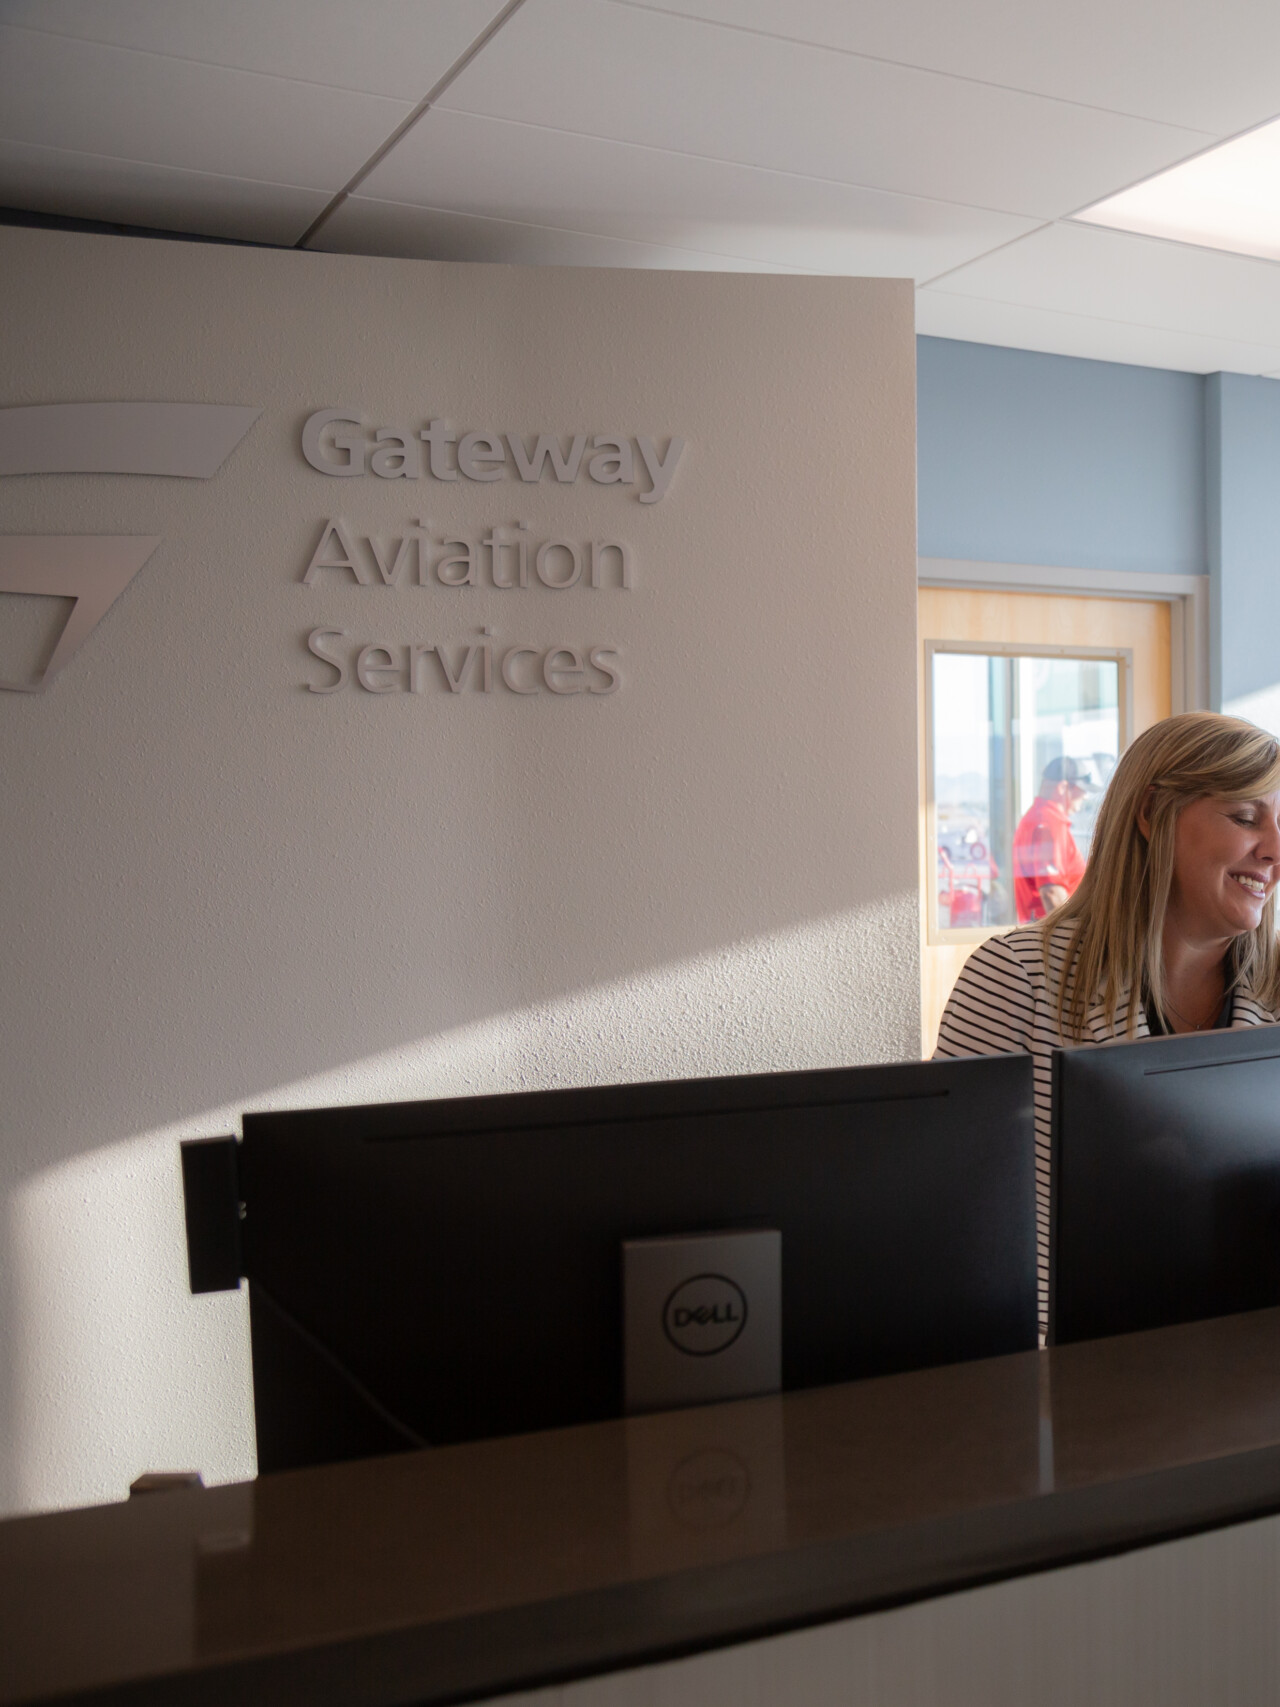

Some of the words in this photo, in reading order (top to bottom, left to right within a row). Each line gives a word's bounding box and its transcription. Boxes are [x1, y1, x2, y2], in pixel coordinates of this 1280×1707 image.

[301, 408, 686, 503] Gateway
[302, 519, 632, 589] Aviation
[306, 626, 623, 695] Services
[674, 1303, 739, 1328] DELL
